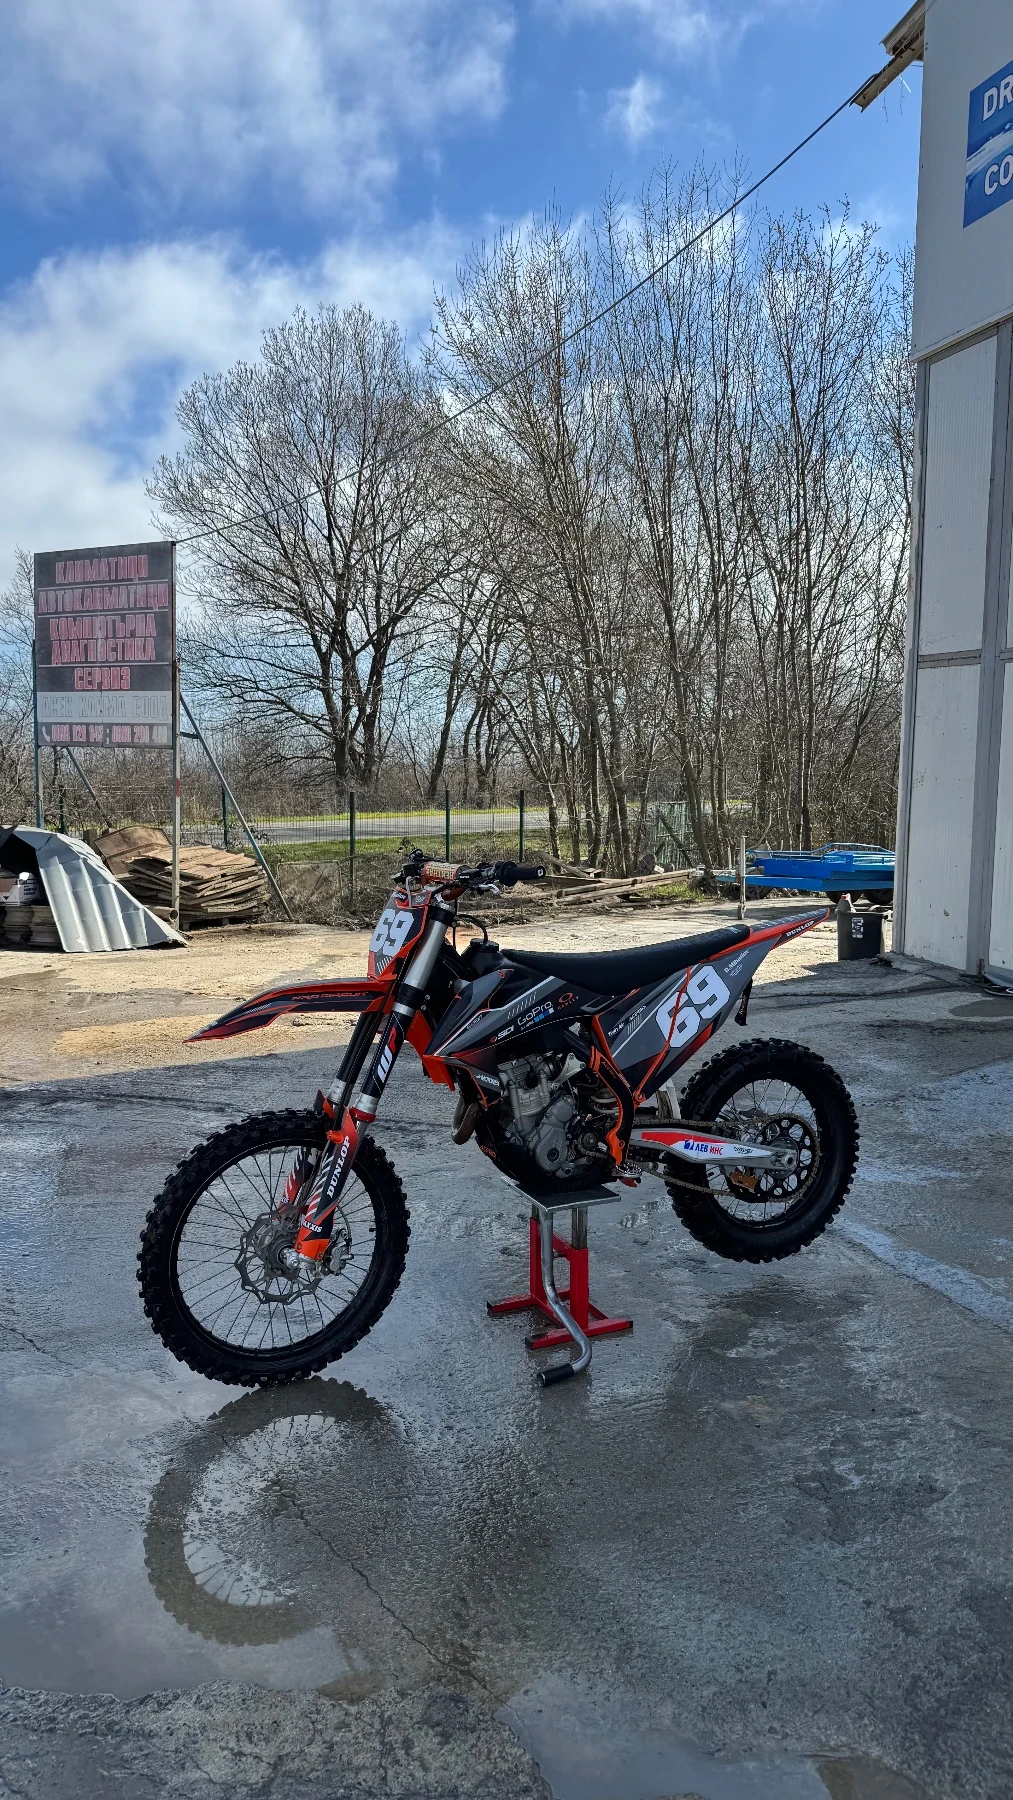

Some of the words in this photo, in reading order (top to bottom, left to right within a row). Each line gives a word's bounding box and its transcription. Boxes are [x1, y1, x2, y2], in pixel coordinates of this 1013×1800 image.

[55, 554, 149, 584] КЛИМАТИЦИ
[38, 583, 169, 613] АВТОКЛИМАТИЦИ
[49, 614, 157, 641] КОМПЮТЪРНА
[52, 638, 156, 666] ДИАГНОСТИКА
[74, 666, 131, 690] СЕРВИЗ
[79, 695, 127, 718] КЛИМА
[132, 695, 168, 721] ЕООД
[369, 908, 415, 957] 69
[786, 920, 815, 937] DUNLOP
[517, 1001, 553, 1026] GoPro
[655, 965, 732, 1048] 69
[326, 1135, 350, 1198] DUNLOP
